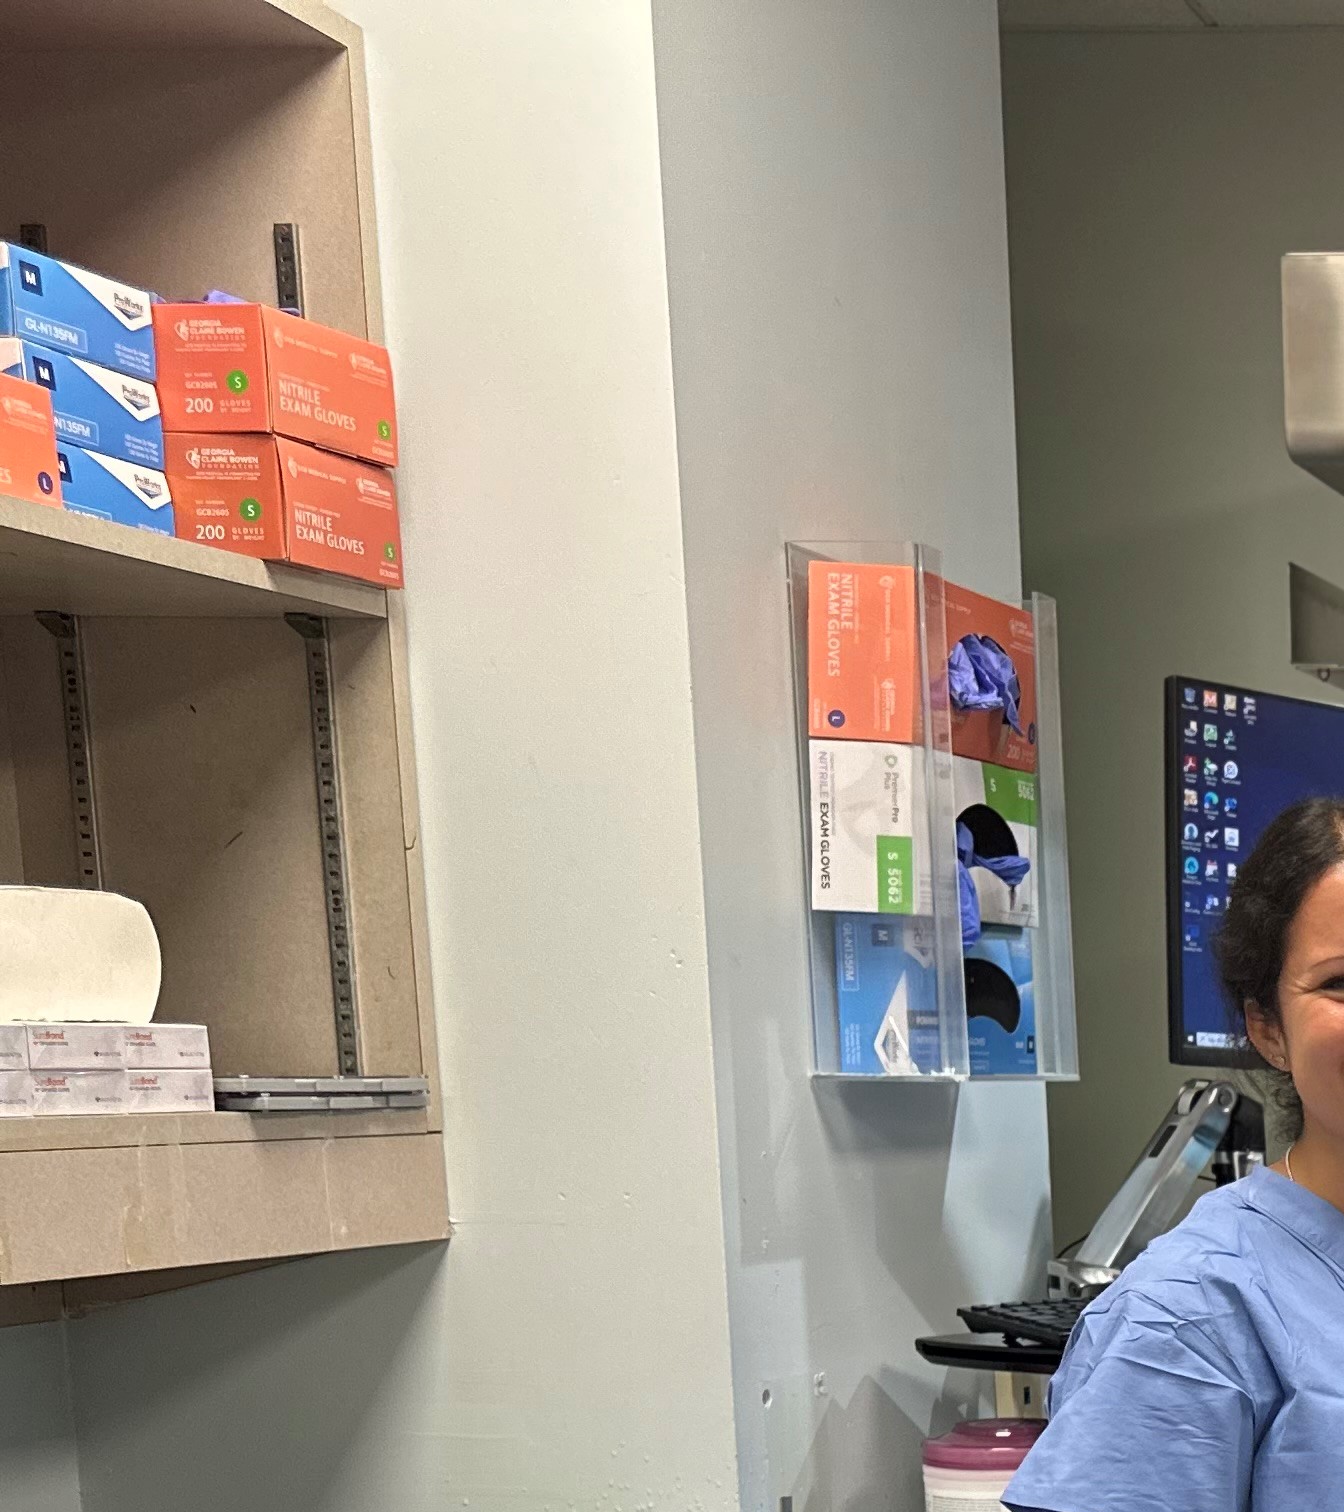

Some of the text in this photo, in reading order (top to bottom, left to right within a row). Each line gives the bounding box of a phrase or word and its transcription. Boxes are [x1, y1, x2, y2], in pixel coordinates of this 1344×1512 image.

[25, 270, 36, 285] M
[39, 366, 51, 381] M
[234, 376, 242, 389] S
[279, 379, 321, 405] NITRILE
[185, 397, 213, 413] 200
[280, 394, 356, 431] EXAM GLOVES
[381, 425, 388, 437] S
[42, 477, 50, 491] L
[247, 505, 255, 516] S
[295, 508, 332, 532] NITRILE
[196, 525, 225, 540] 200
[295, 524, 365, 555] EXAM GLOVES
[387, 547, 393, 558] S
[841, 574, 854, 630] NITRILE
[827, 572, 840, 677] EXAM GLOVES
[818, 751, 831, 889] NITRILE EXAM GLOVES
[888, 852, 900, 904] S 5062
[878, 930, 889, 941] M
